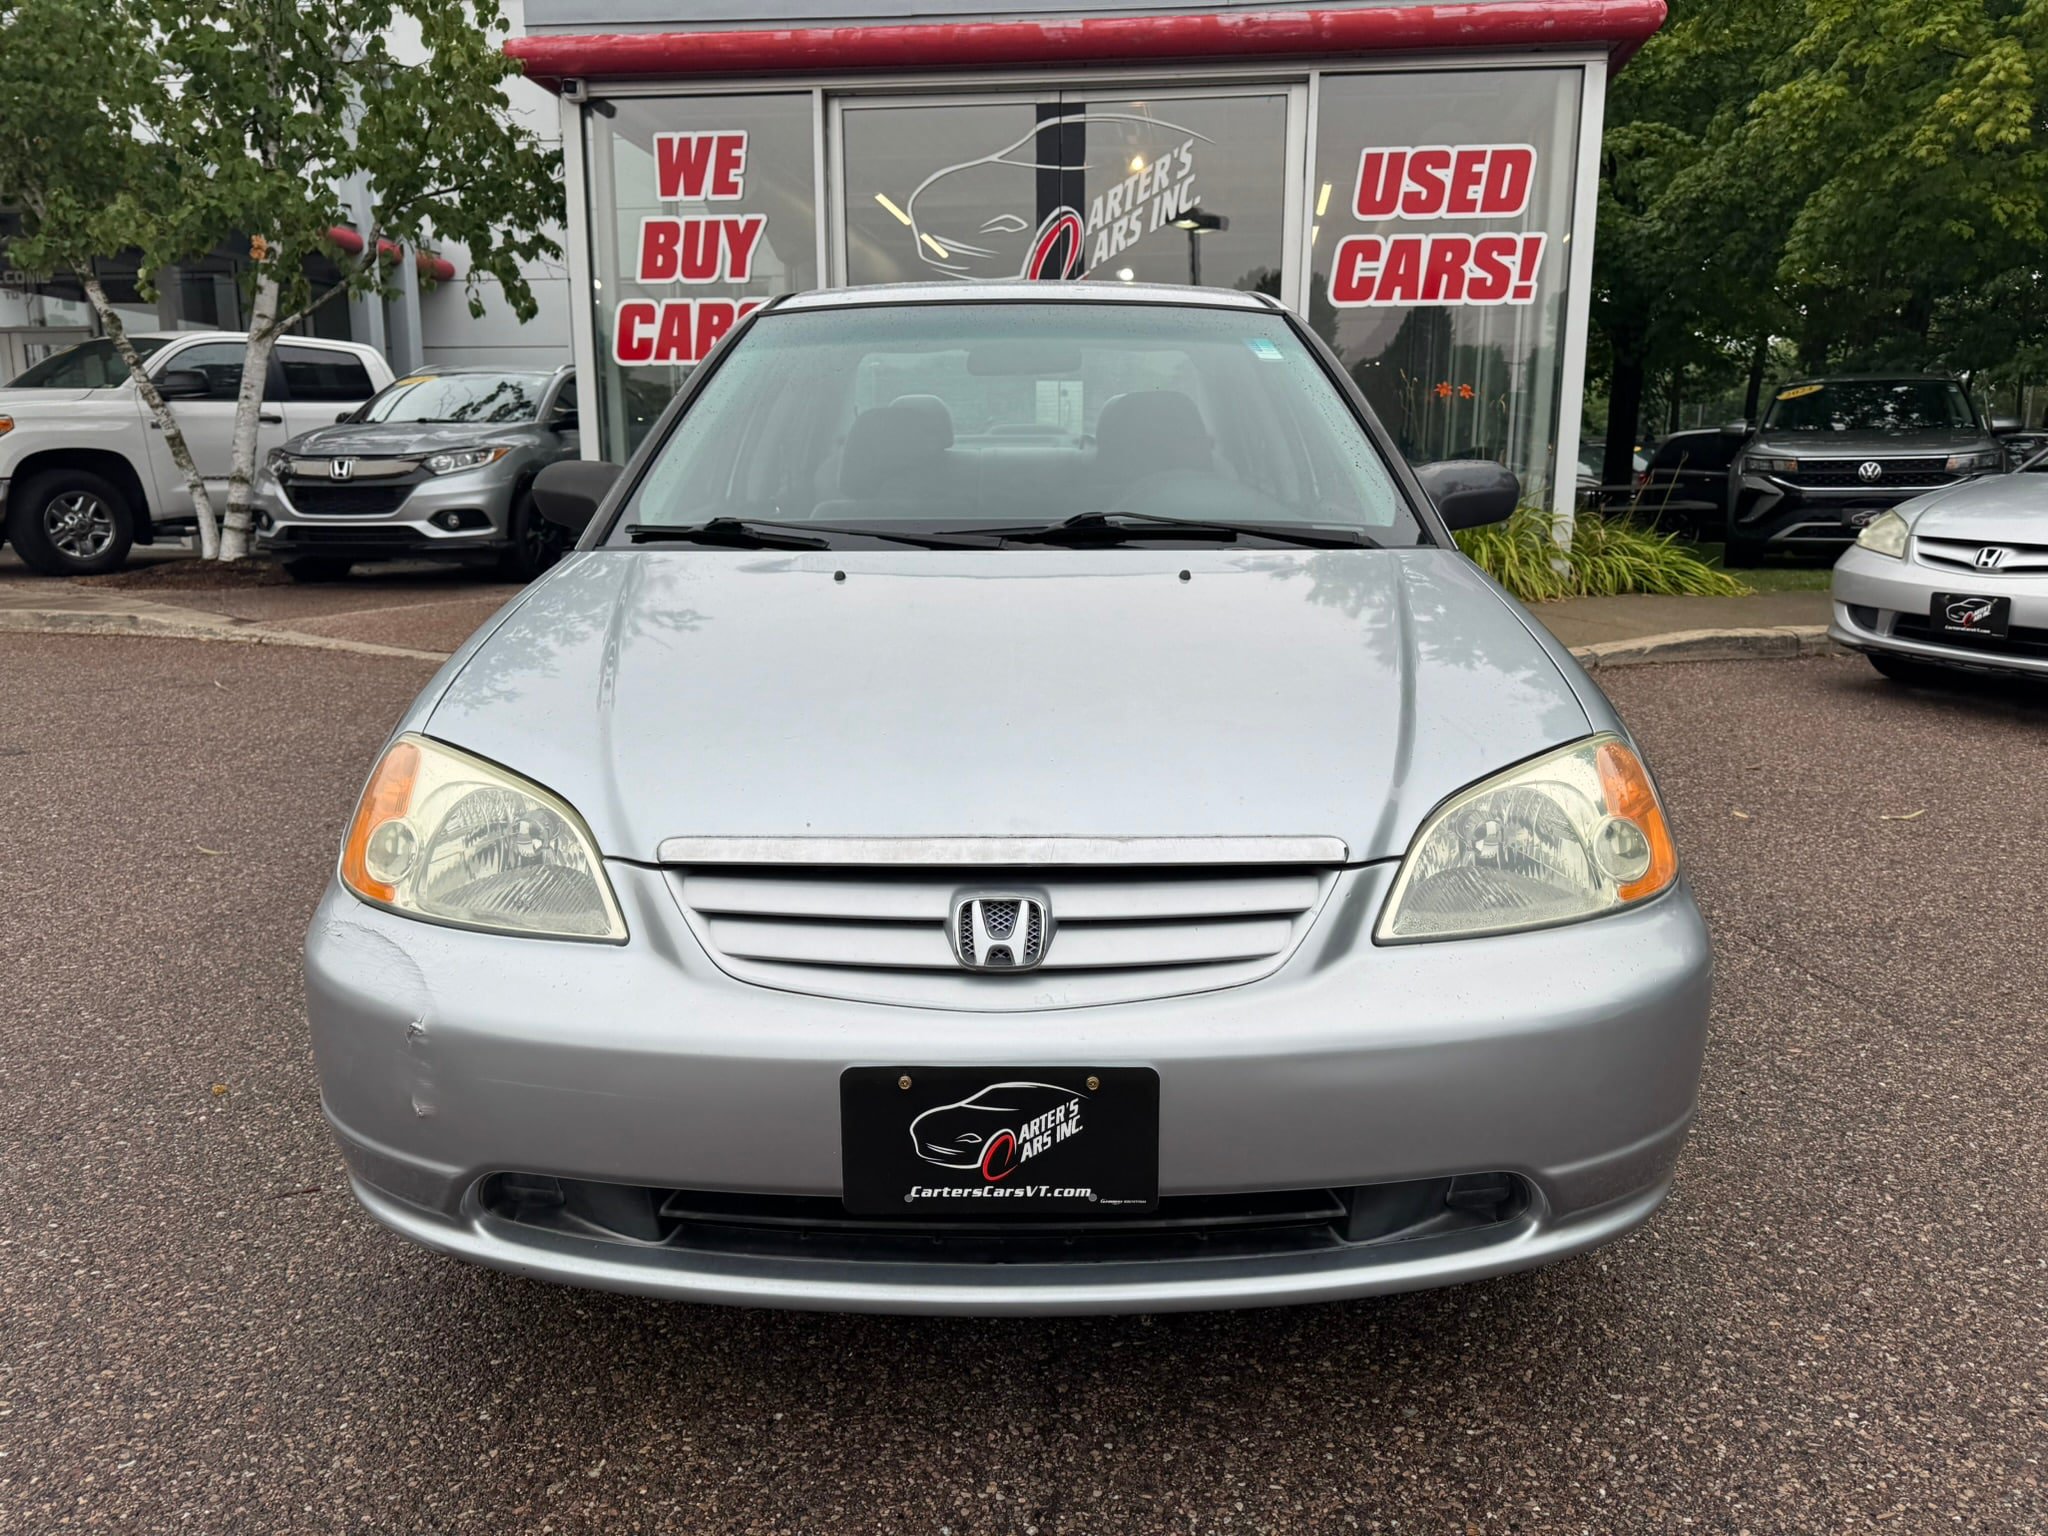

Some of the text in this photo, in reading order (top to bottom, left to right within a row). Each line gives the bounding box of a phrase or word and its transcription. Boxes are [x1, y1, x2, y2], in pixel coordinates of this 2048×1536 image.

[655, 132, 746, 200] WE
[1354, 146, 1535, 219] USED
[1150, 173, 1201, 233] INC.
[638, 216, 765, 282] BUY
[1330, 234, 1545, 305] CARS!
[1056, 1115, 1083, 1143] INC.
[910, 1185, 1092, 1198] CartersCarsVT.com
